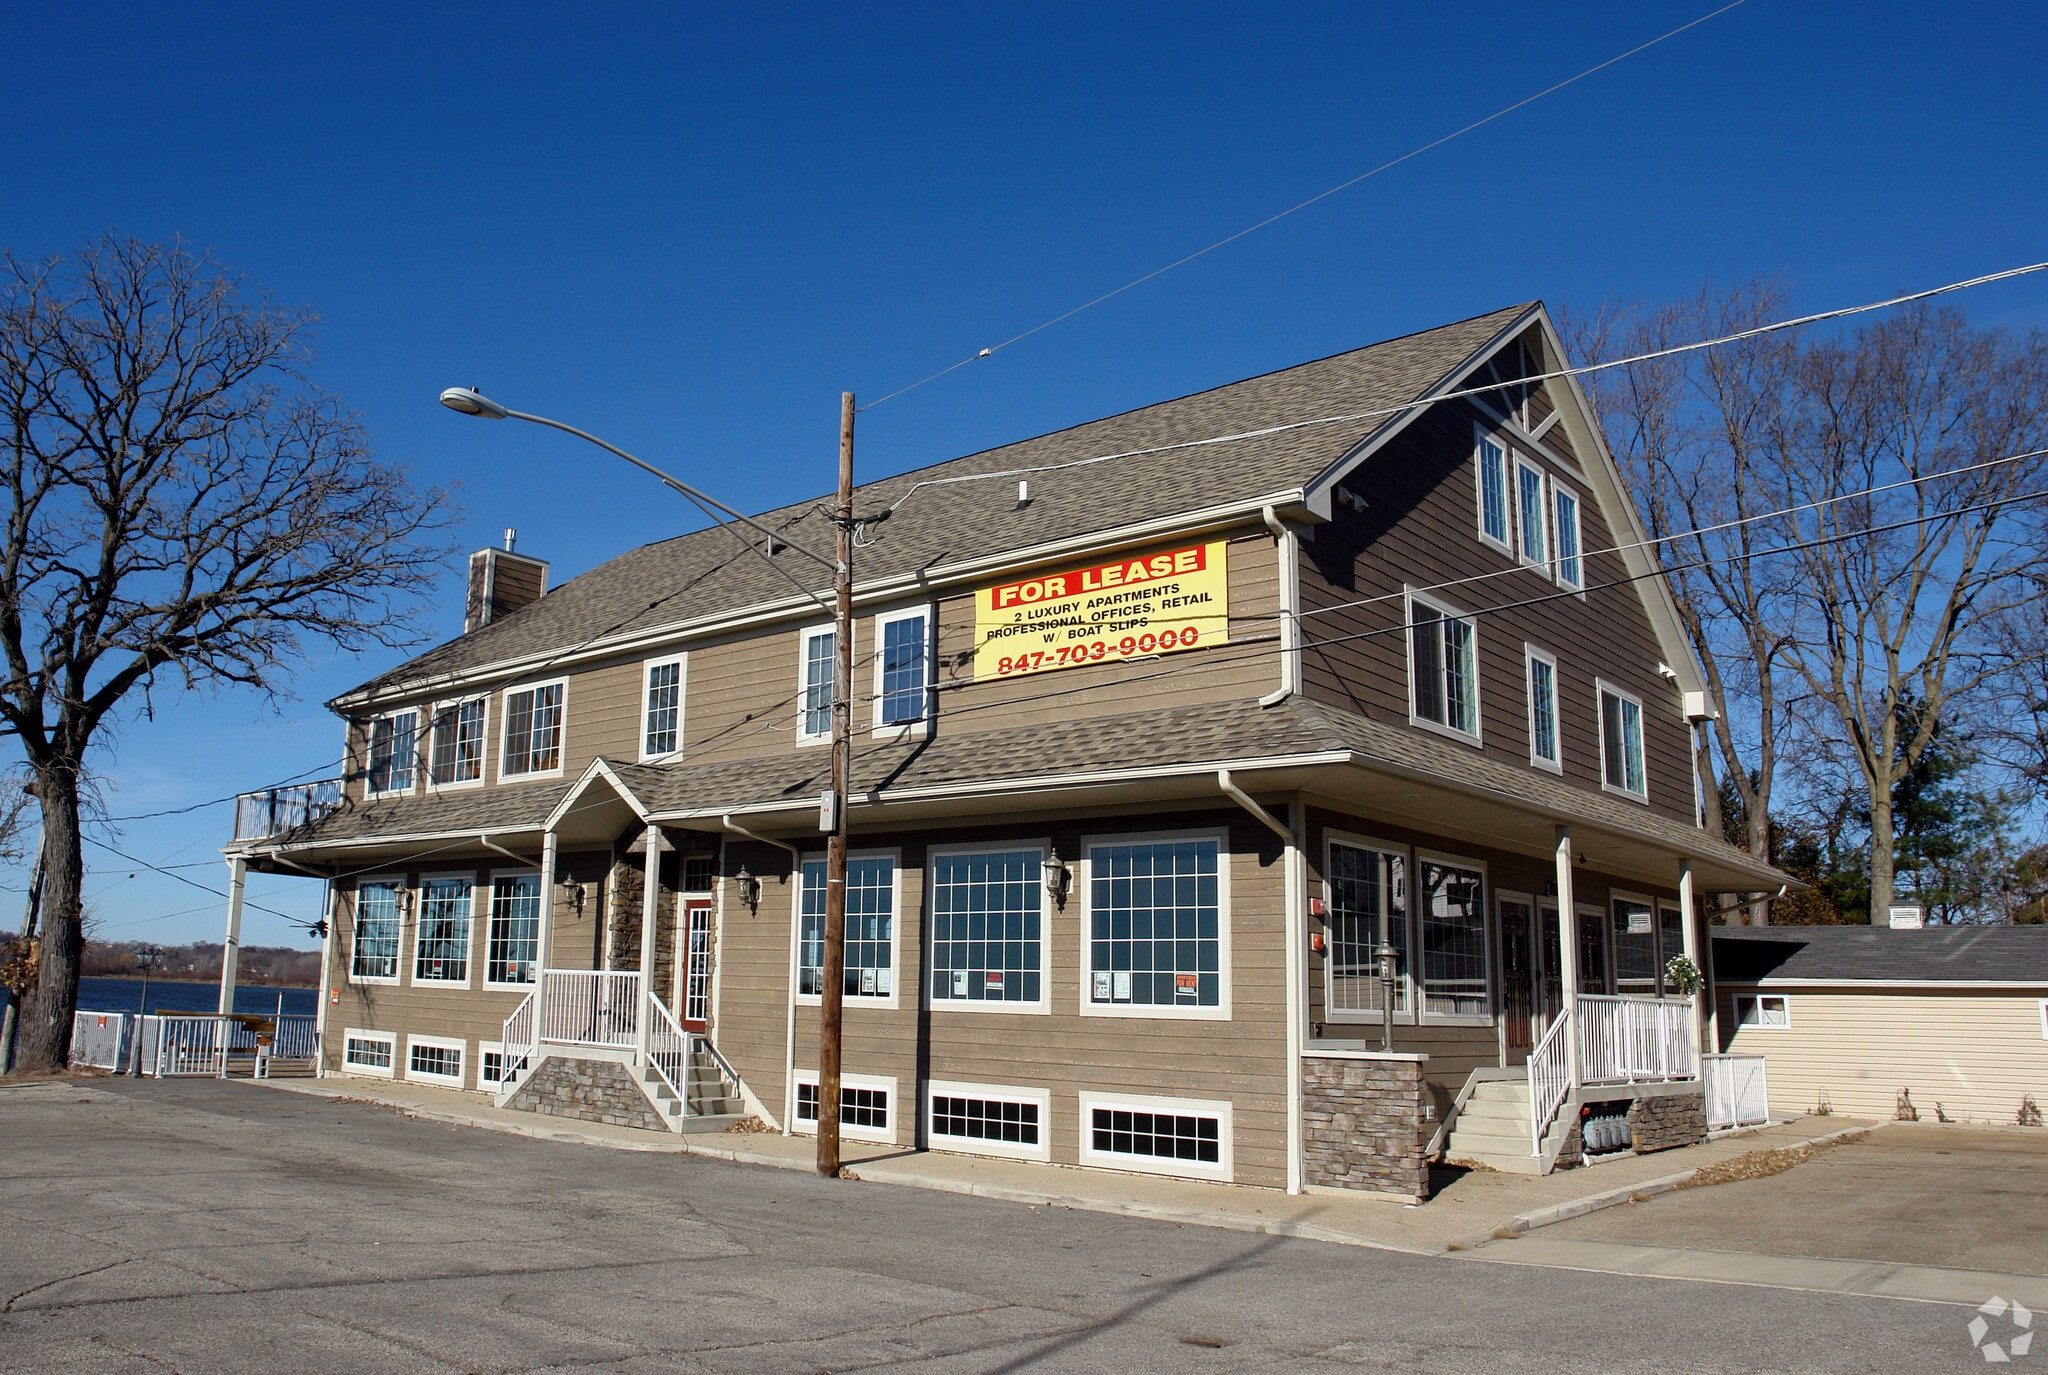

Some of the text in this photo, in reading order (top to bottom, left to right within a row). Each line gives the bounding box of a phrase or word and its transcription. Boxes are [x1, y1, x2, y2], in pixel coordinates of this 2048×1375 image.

[1000, 549, 1198, 607] FOR LEASE
[987, 592, 1213, 640] PROFESSIONAL OFFICES, RETAIL
[1014, 583, 1180, 622] 2 LUXURY APARTMENTS
[997, 626, 1199, 675] 847-703-9000
[1068, 625, 1103, 639] BOAT
[1109, 617, 1148, 632] SLIPS
